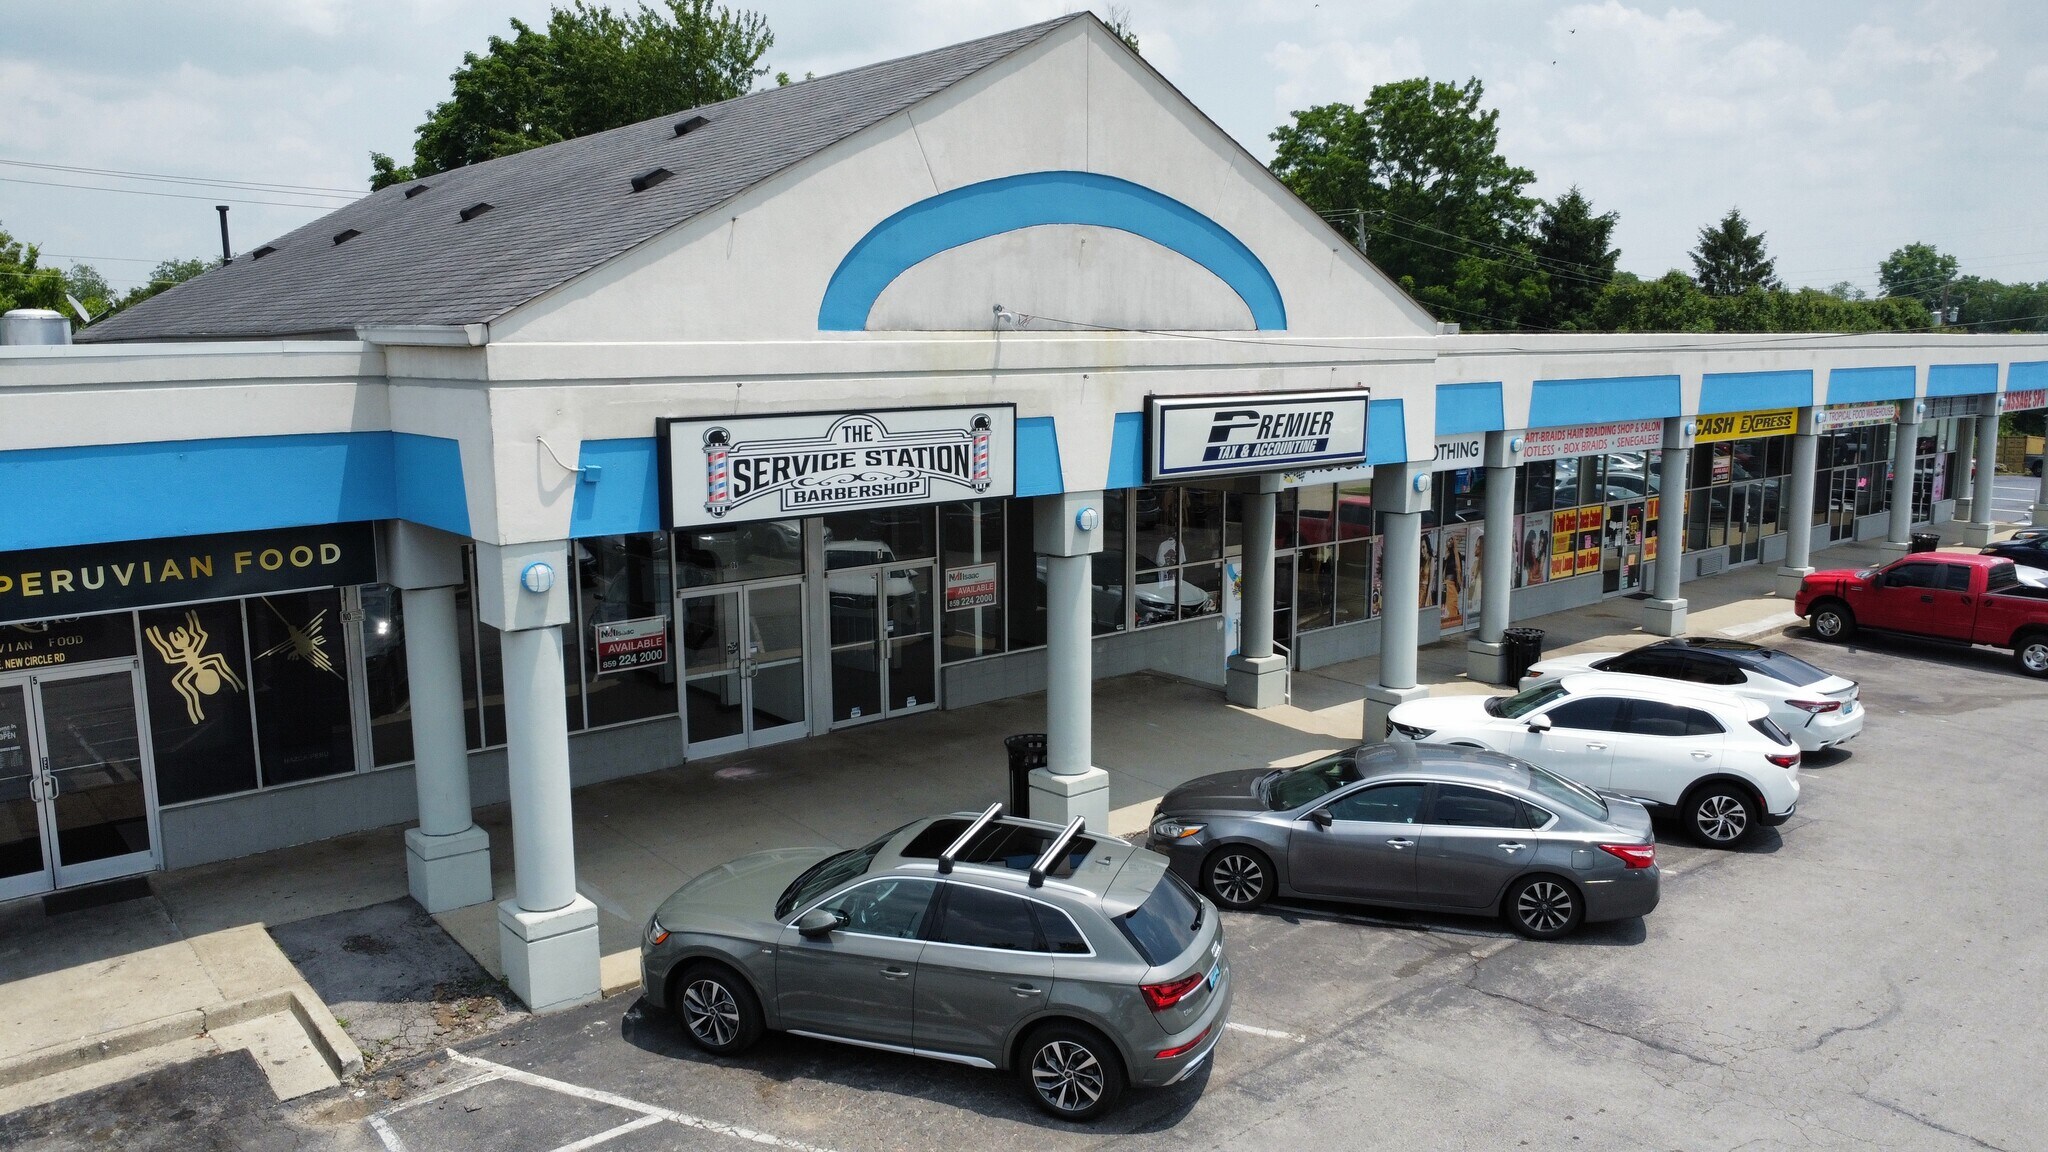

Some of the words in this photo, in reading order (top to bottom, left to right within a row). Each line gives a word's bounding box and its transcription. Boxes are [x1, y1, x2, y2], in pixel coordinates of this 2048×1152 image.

[2033, 389, 2045, 407] SPA
[1829, 410, 1851, 421] TROPICAL
[1853, 409, 1865, 419] FOOD
[1866, 406, 1893, 418] WAREHOUSE
[841, 425, 873, 443] THE
[1208, 410, 1334, 443] PREMIER
[1567, 428, 1584, 440] HAIR
[1585, 425, 1616, 438] BRAIDING
[1617, 423, 1634, 434] SHOP
[1635, 422, 1639, 432] &
[1640, 421, 1661, 432] SALON
[1695, 416, 1735, 436] CASH
[1741, 414, 1792, 433] EXPRESS
[1218, 445, 1239, 459] TAX
[1240, 444, 1250, 457] &
[1252, 439, 1317, 456] ACCOUNTING
[1563, 442, 1580, 453] BOX
[1581, 439, 1608, 452] BRAIDS
[1617, 434, 1660, 448] SENEGALESE
[733, 450, 856, 498] SERVICE
[865, 444, 970, 479] STATION
[794, 480, 919, 503] BARBERSHOP
[234, 543, 341, 574] FOOD
[958, 583, 994, 595] AVAILABLE
[961, 596, 974, 606] 224
[976, 594, 993, 603] 2000
[48, 635, 83, 648] FOOD
[608, 638, 662, 654] AVAILABLE
[5, 657, 23, 669] NEW
[25, 654, 53, 666] CIRCLE
[54, 652, 65, 662] RD
[603, 660, 617, 668] 859
[619, 654, 637, 666] 224
[640, 649, 663, 662] 2000
[33, 676, 38, 685] 5
